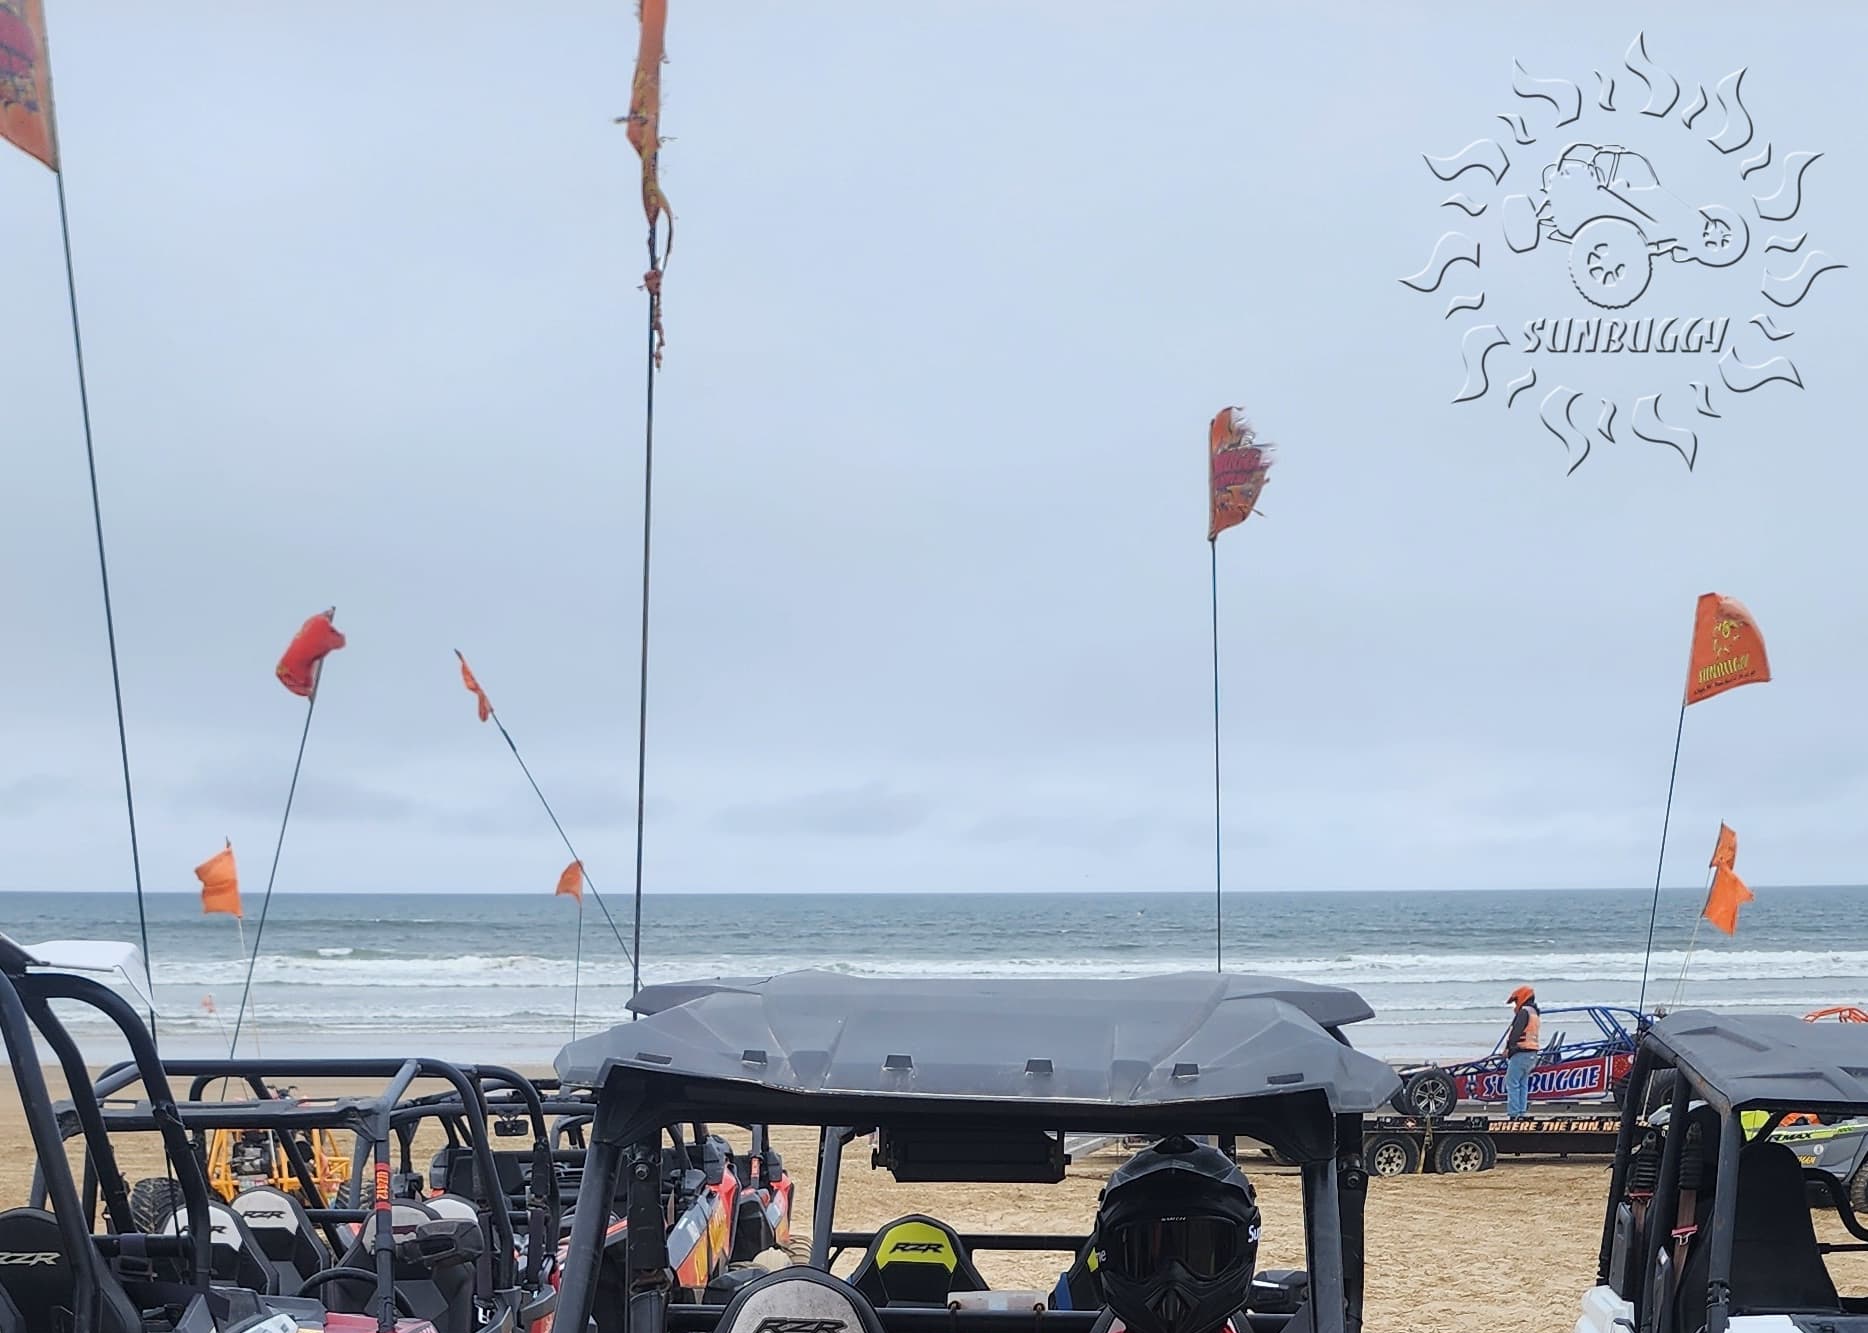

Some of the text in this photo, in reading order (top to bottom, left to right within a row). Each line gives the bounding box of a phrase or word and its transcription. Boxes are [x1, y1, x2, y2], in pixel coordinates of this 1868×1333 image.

[1483, 1066, 1600, 1097] SUBUGGIE
[1488, 1121, 1537, 1132] WHERE
[1543, 1121, 1567, 1132] THE
[1571, 1120, 1599, 1132] FUN
[241, 1210, 287, 1219] RZR
[179, 1225, 227, 1234] RR
[1248, 1225, 1261, 1243] Su
[889, 1242, 944, 1254] RZR
